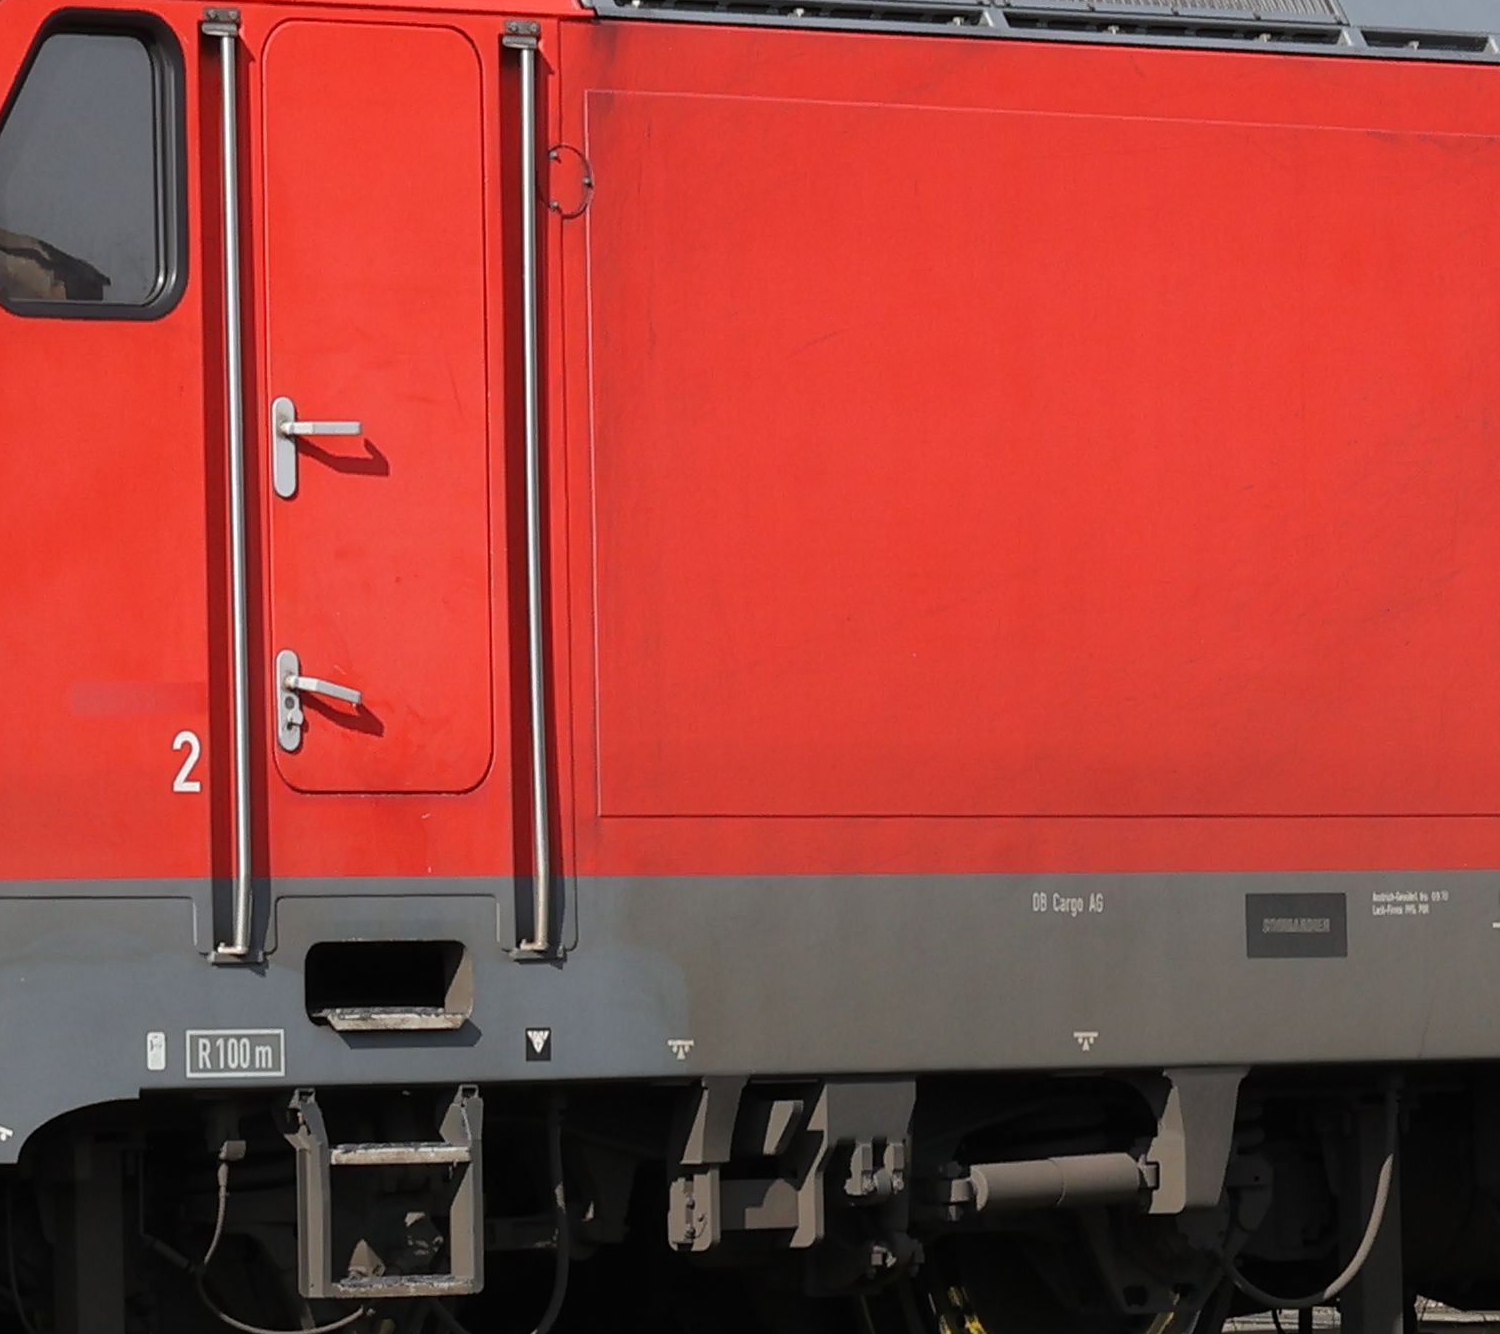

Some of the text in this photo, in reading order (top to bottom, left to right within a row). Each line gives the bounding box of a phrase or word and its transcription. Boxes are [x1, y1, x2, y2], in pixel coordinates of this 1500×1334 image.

[172, 730, 201, 792] 2
[1032, 892, 1104, 917] DB Cargo AG
